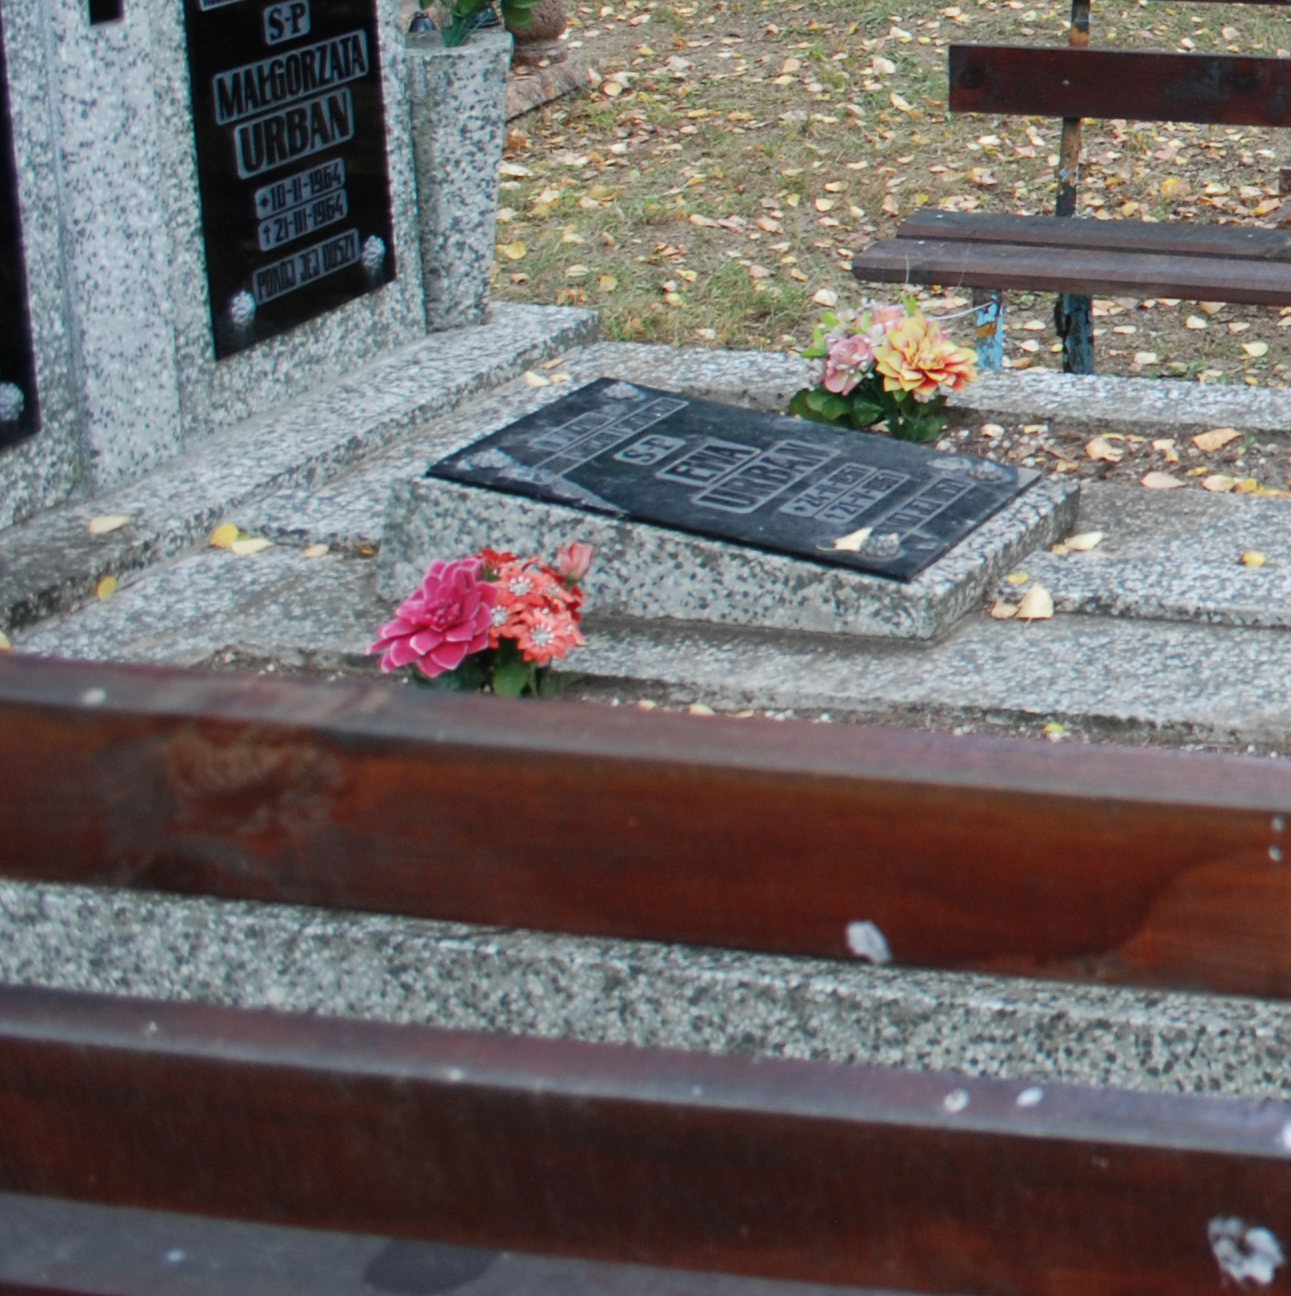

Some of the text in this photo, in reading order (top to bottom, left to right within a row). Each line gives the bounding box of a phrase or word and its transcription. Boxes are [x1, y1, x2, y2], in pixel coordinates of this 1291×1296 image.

[216, 32, 367, 122] MAŁGORZATA
[239, 89, 350, 175] URBAN
[663, 442, 754, 482] EWA
[697, 441, 834, 511] URBAN
